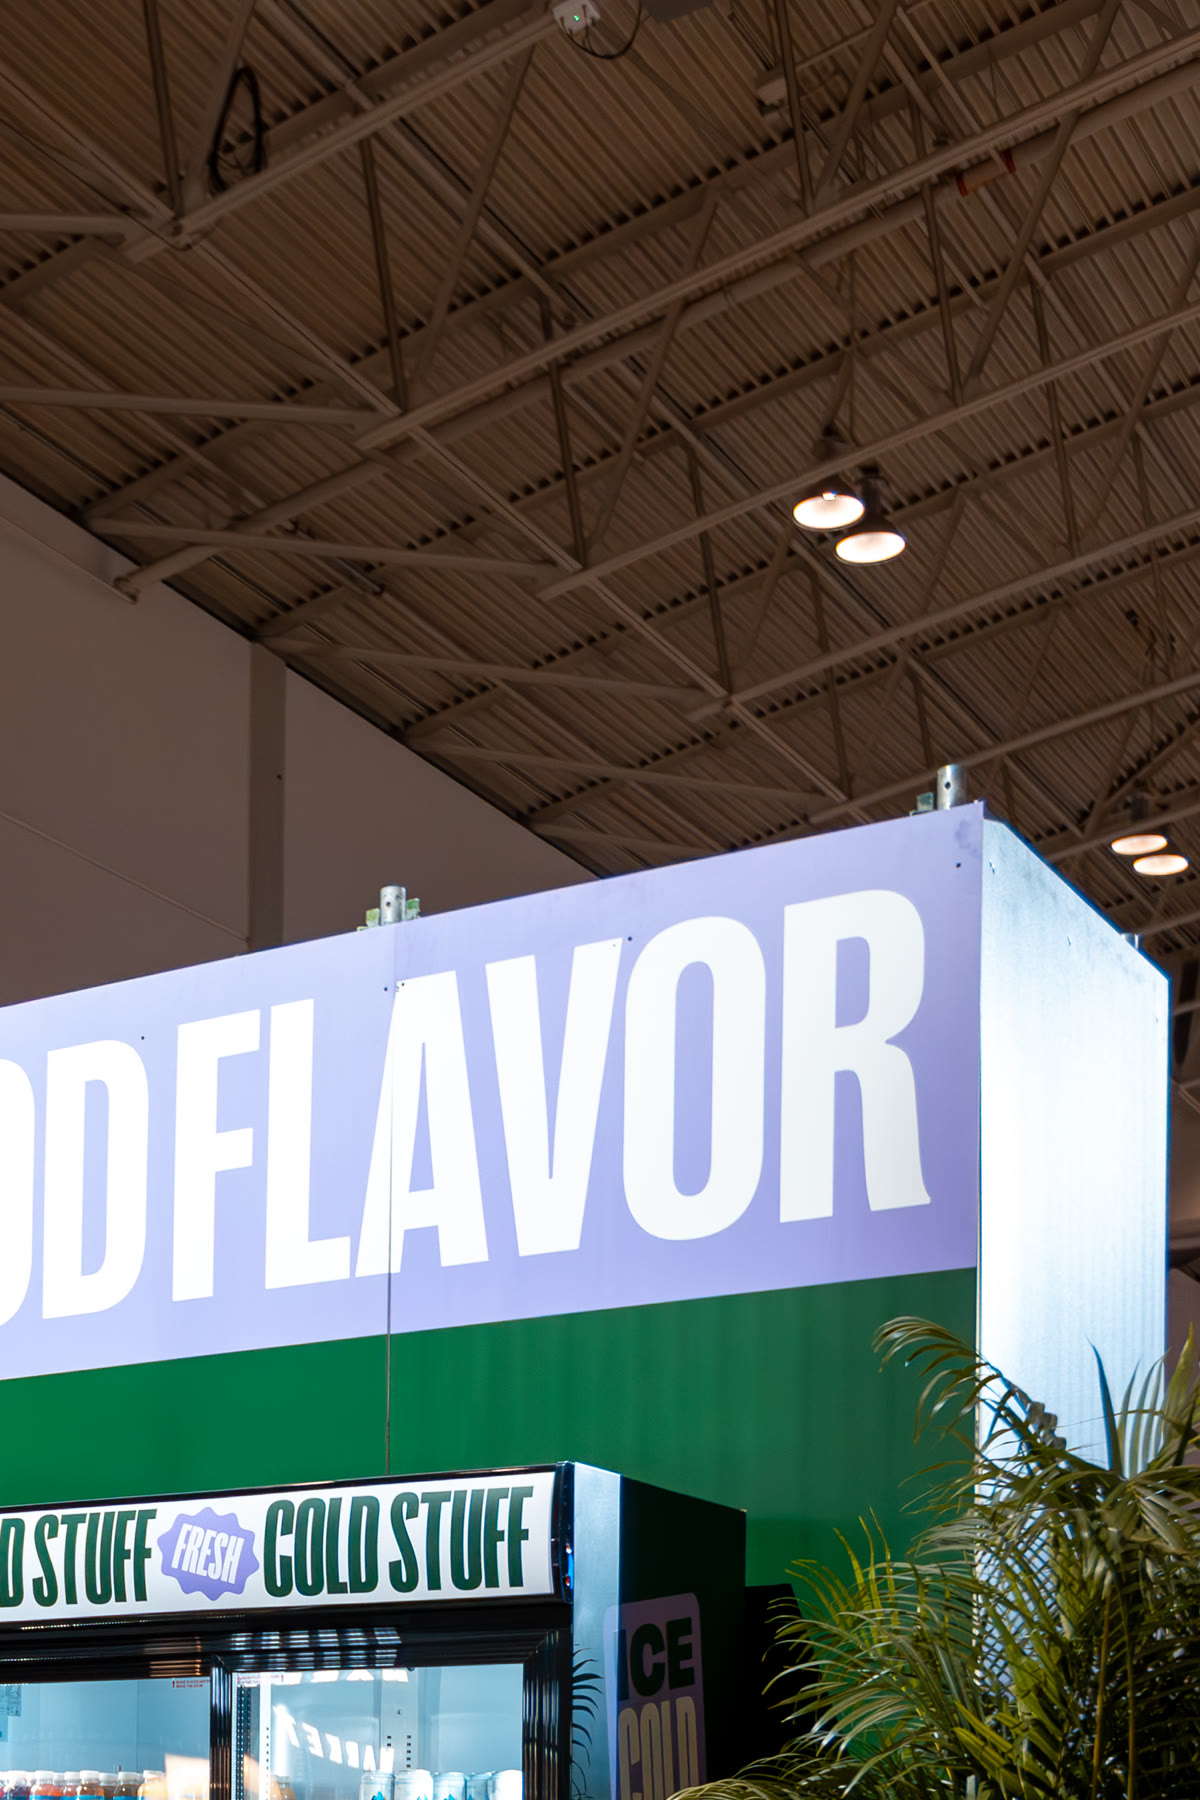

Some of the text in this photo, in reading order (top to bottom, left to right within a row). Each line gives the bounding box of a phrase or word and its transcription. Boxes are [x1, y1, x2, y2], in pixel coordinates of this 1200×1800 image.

[171, 889, 932, 1303] FLAVOR
[31, 1508, 159, 1608] STUFF
[170, 1522, 245, 1585] FRESH
[263, 1485, 534, 1598] COLD STUFF
[616, 1616, 696, 1701] ICE
